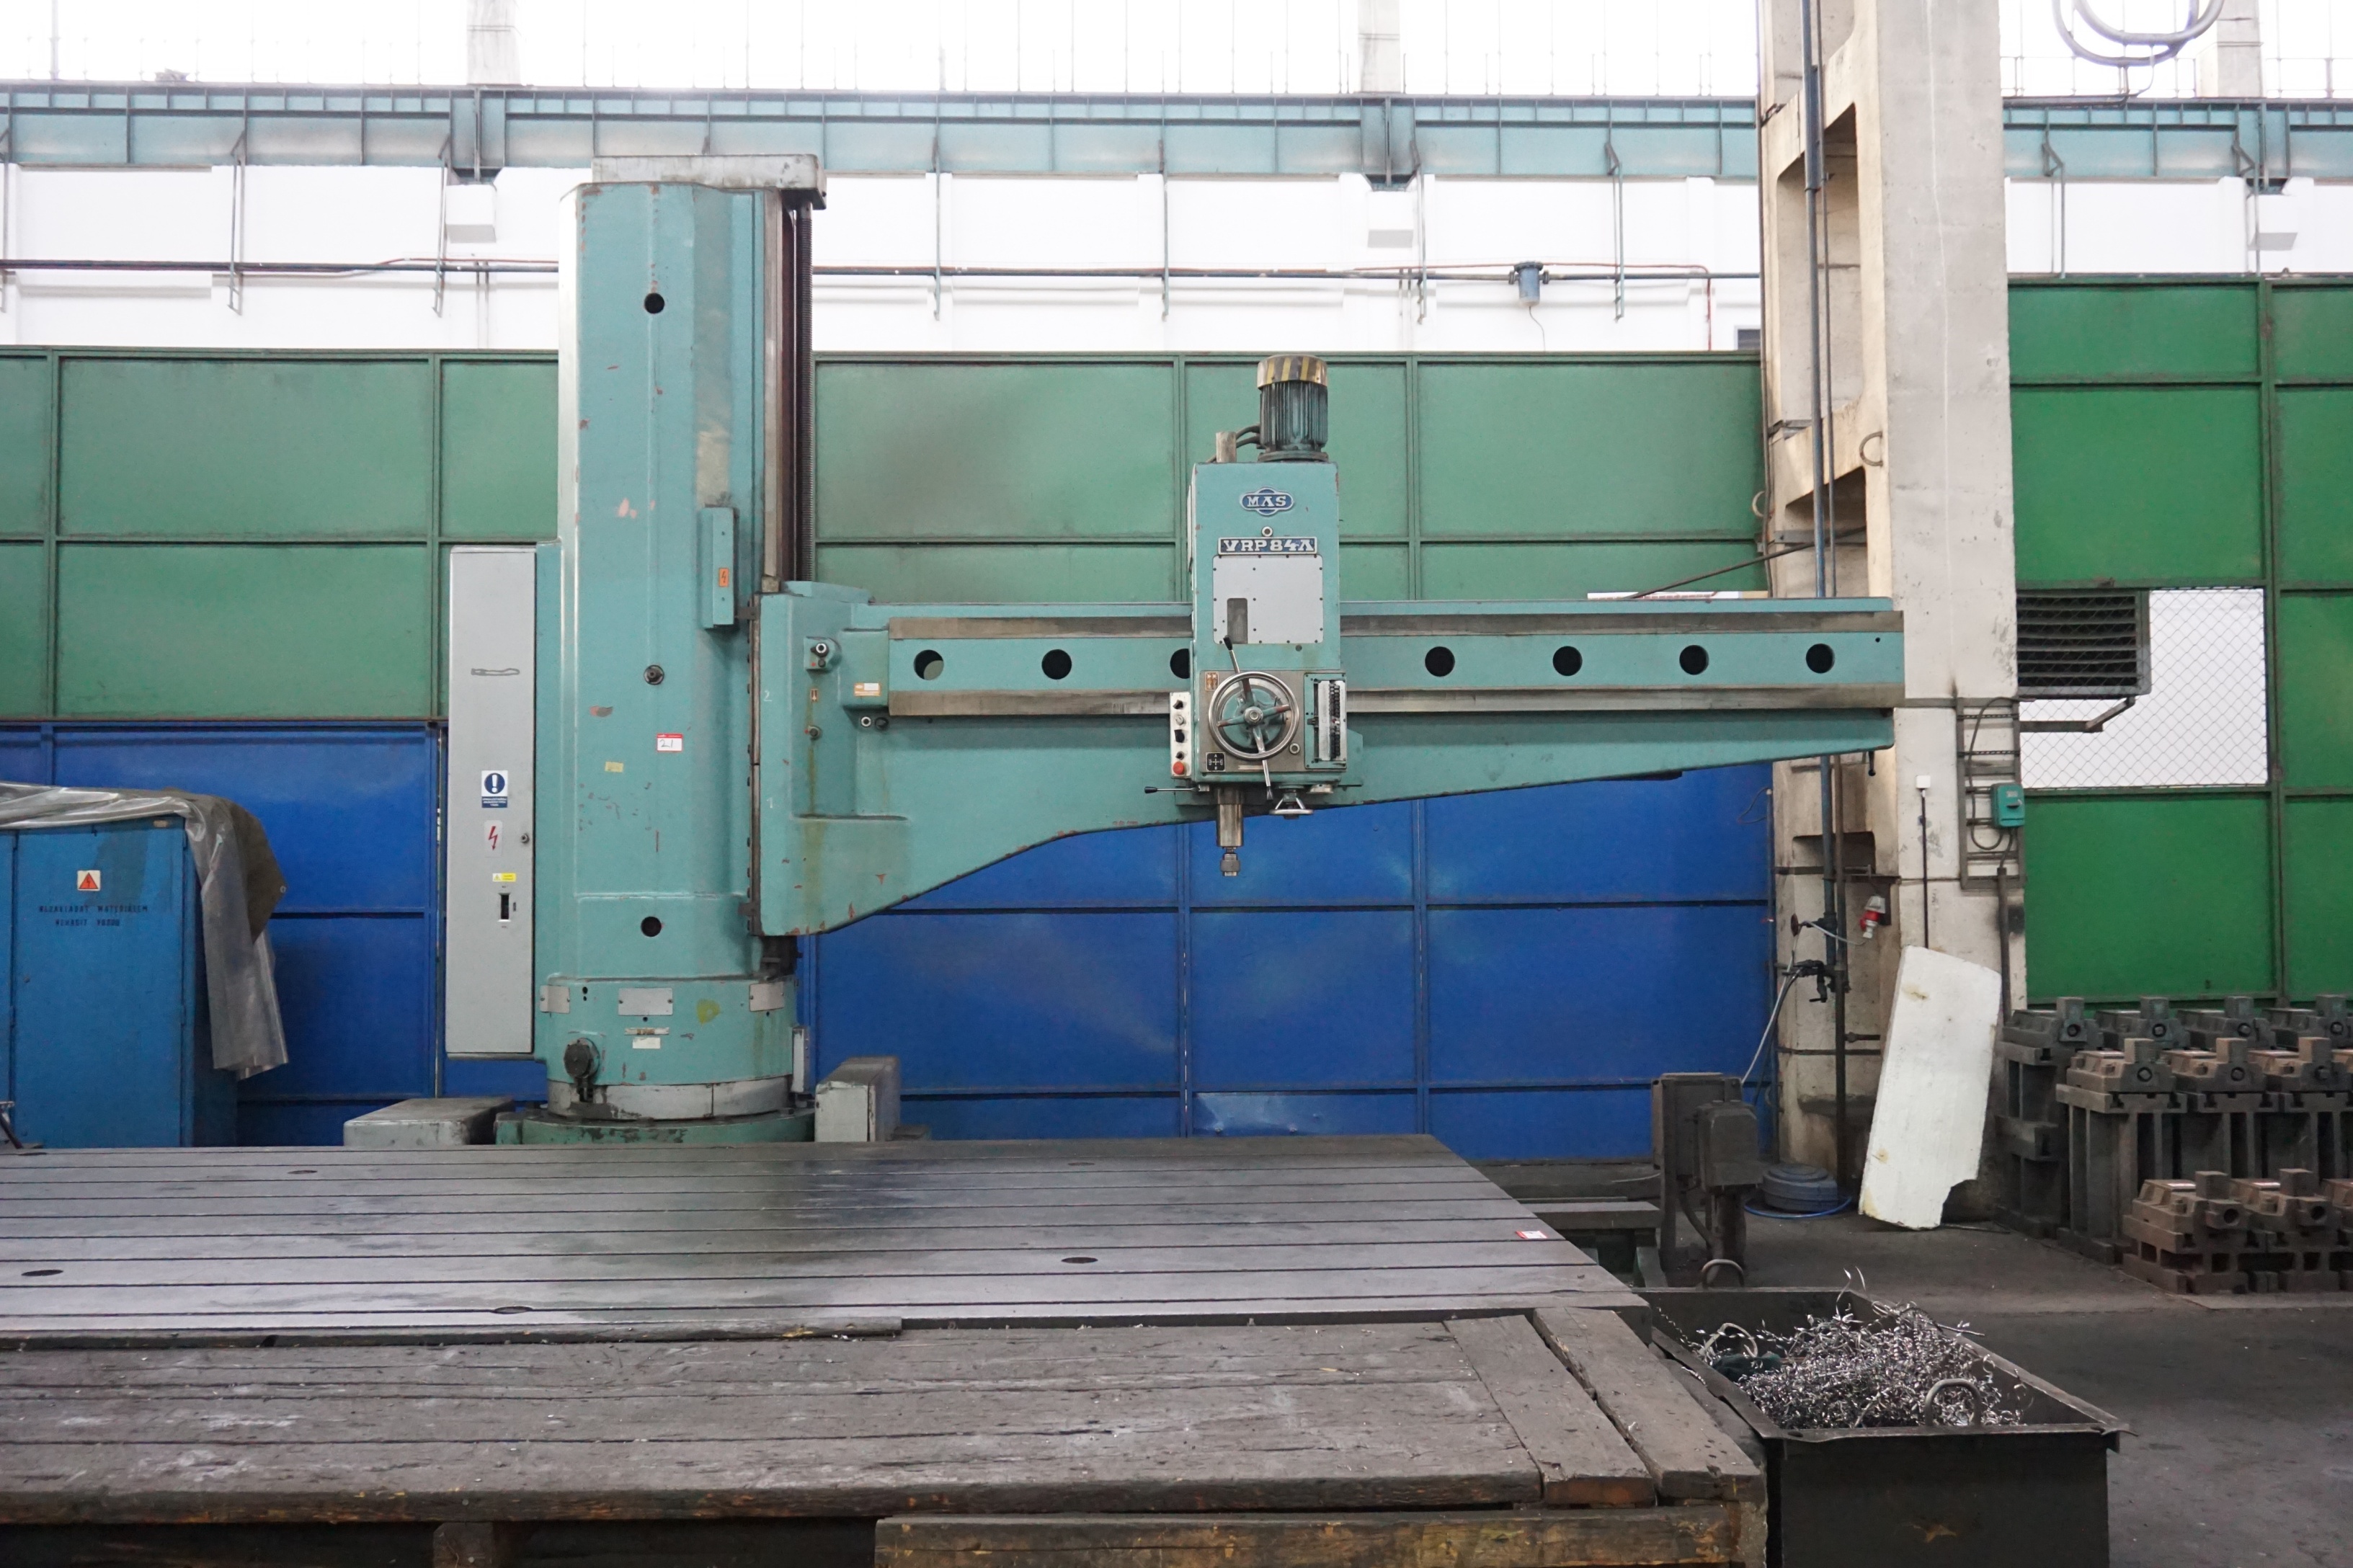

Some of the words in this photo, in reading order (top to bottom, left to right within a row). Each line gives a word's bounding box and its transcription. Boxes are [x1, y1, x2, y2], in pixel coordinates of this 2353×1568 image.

[1247, 496, 1286, 507] MAS
[764, 690, 773, 702] 2
[659, 739, 674, 749] 21
[766, 797, 773, 808] 1
